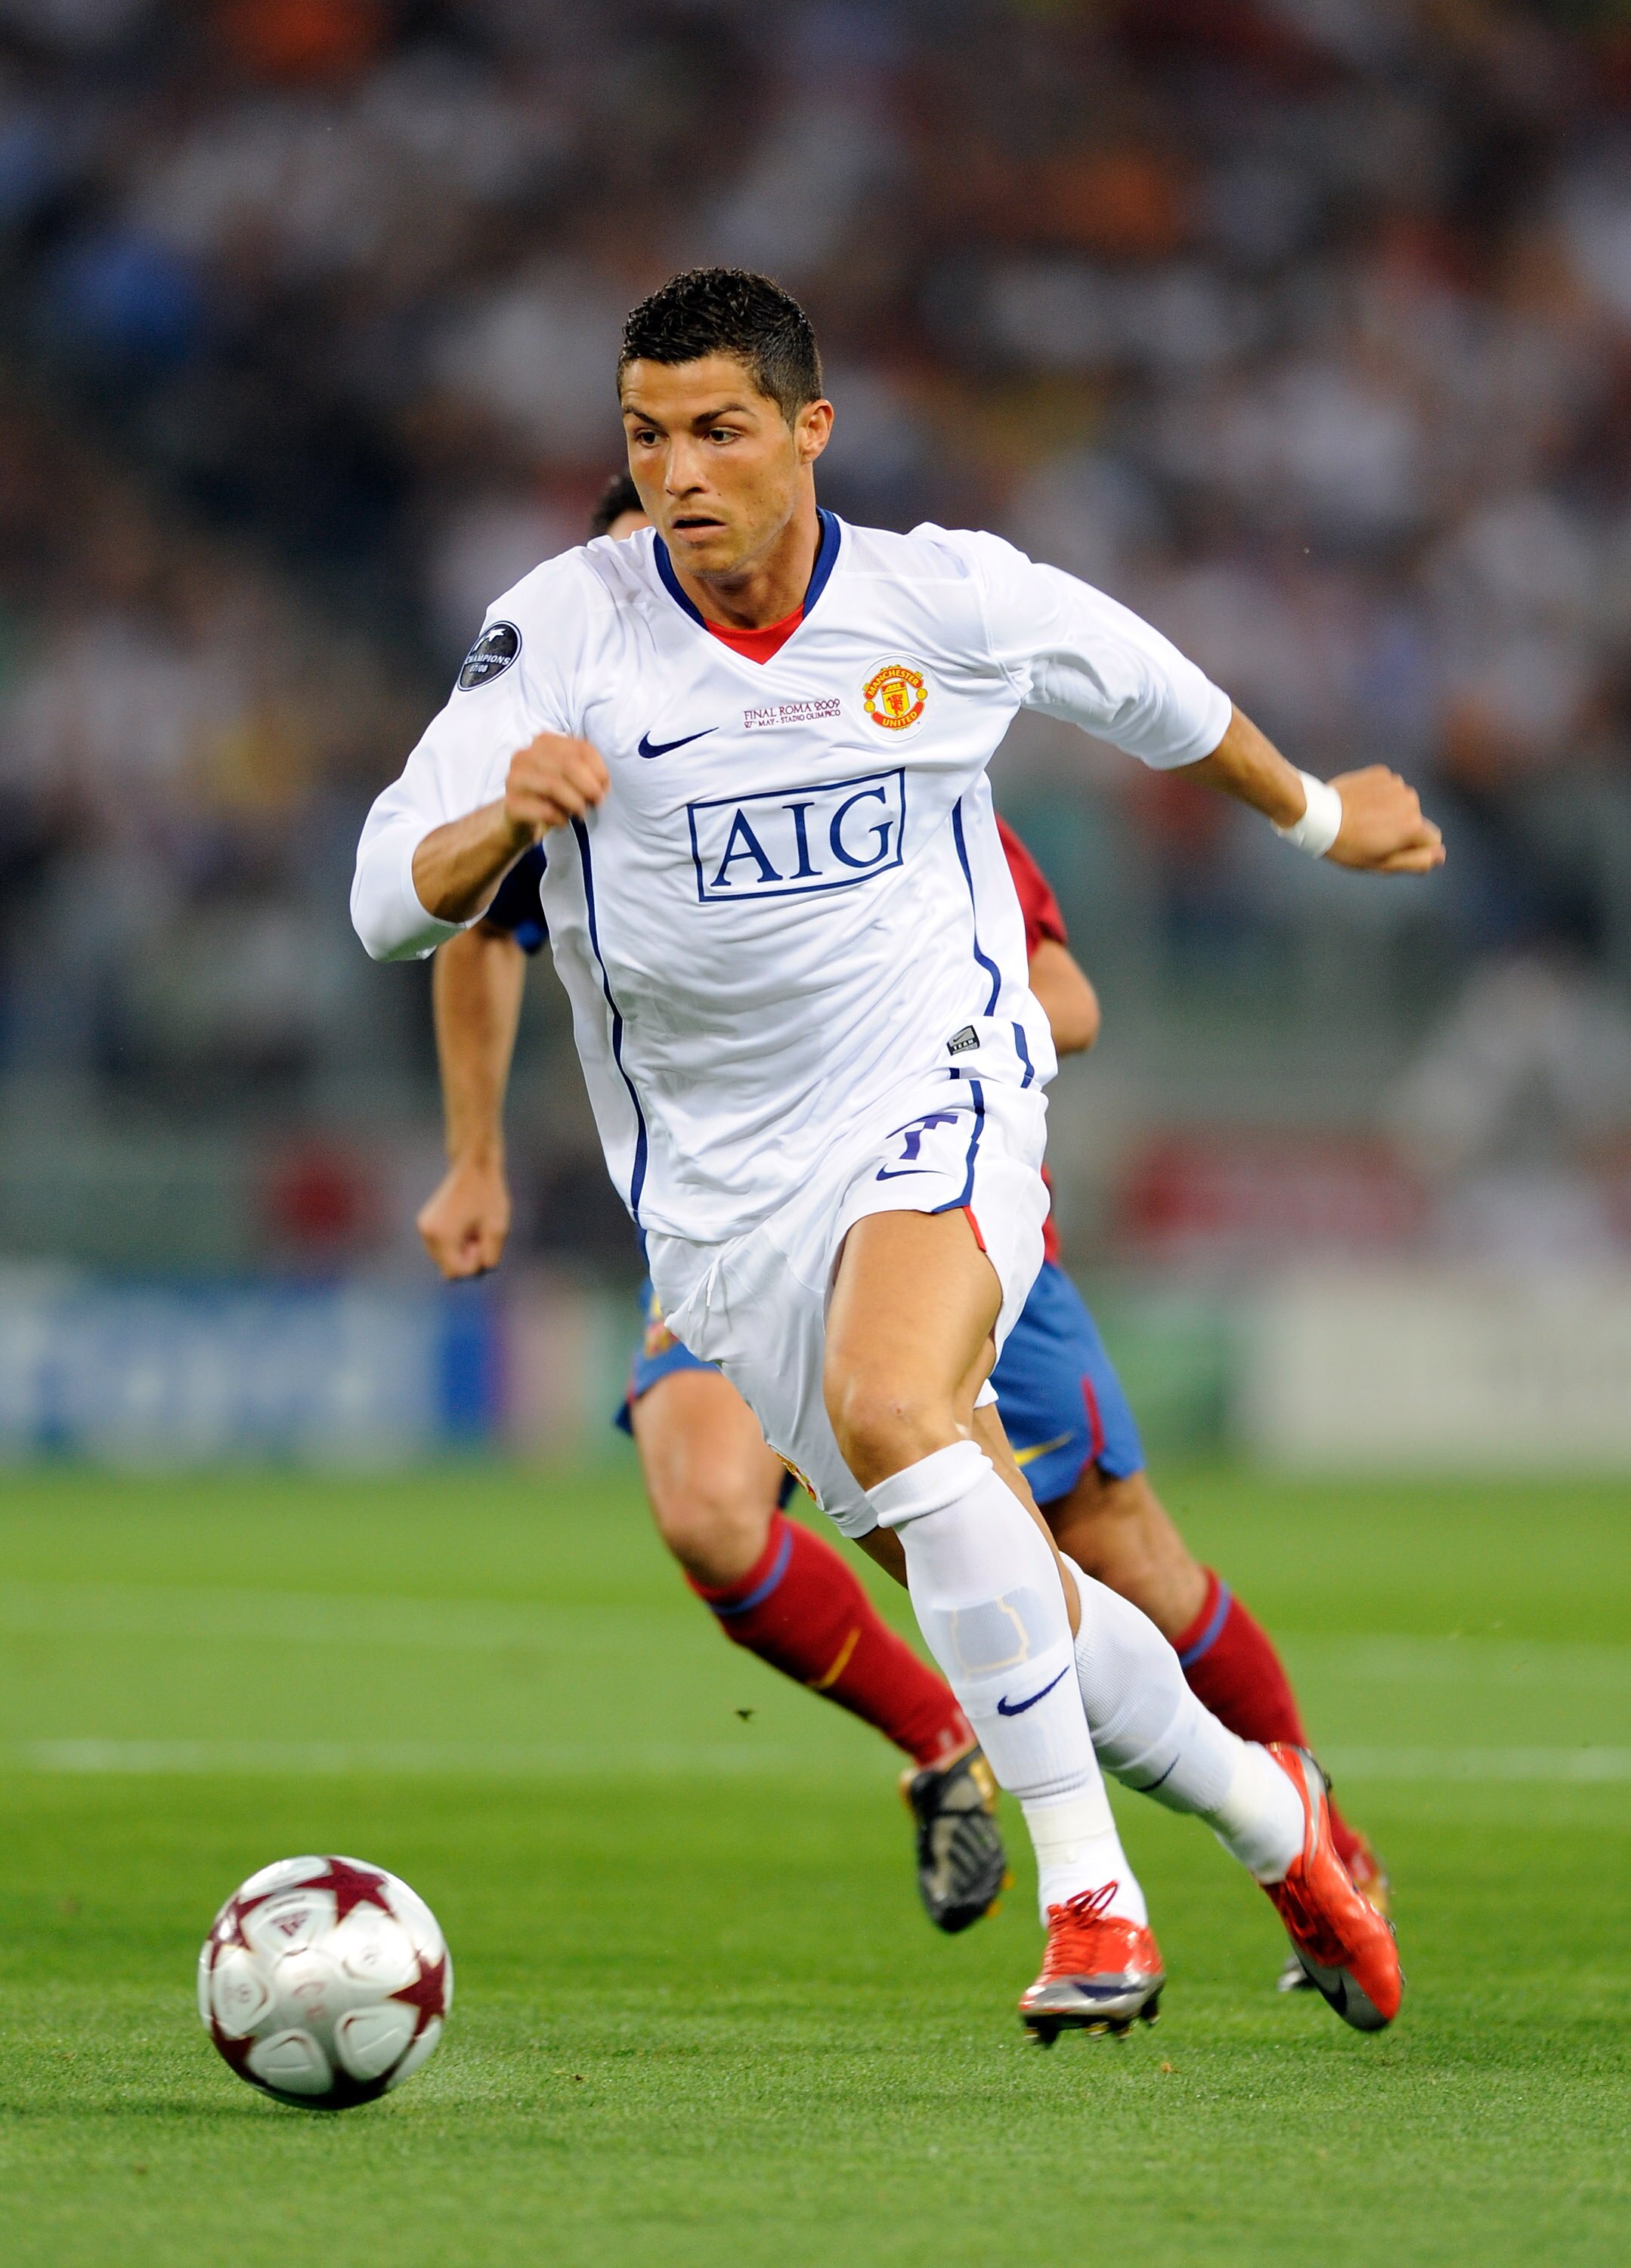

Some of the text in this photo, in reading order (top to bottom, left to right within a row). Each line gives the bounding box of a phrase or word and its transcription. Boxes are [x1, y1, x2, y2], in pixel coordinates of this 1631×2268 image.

[466, 654, 511, 665] CHAMPIONS
[868, 669, 919, 696] MANCHESTER
[744, 698, 840, 720] FINAL ROMA 2009
[758, 718, 775, 727] MAY
[781, 714, 805, 723] STADIO
[806, 709, 840, 720] OLIMPICO
[882, 711, 918, 727] UNITED
[710, 786, 893, 887] AIG
